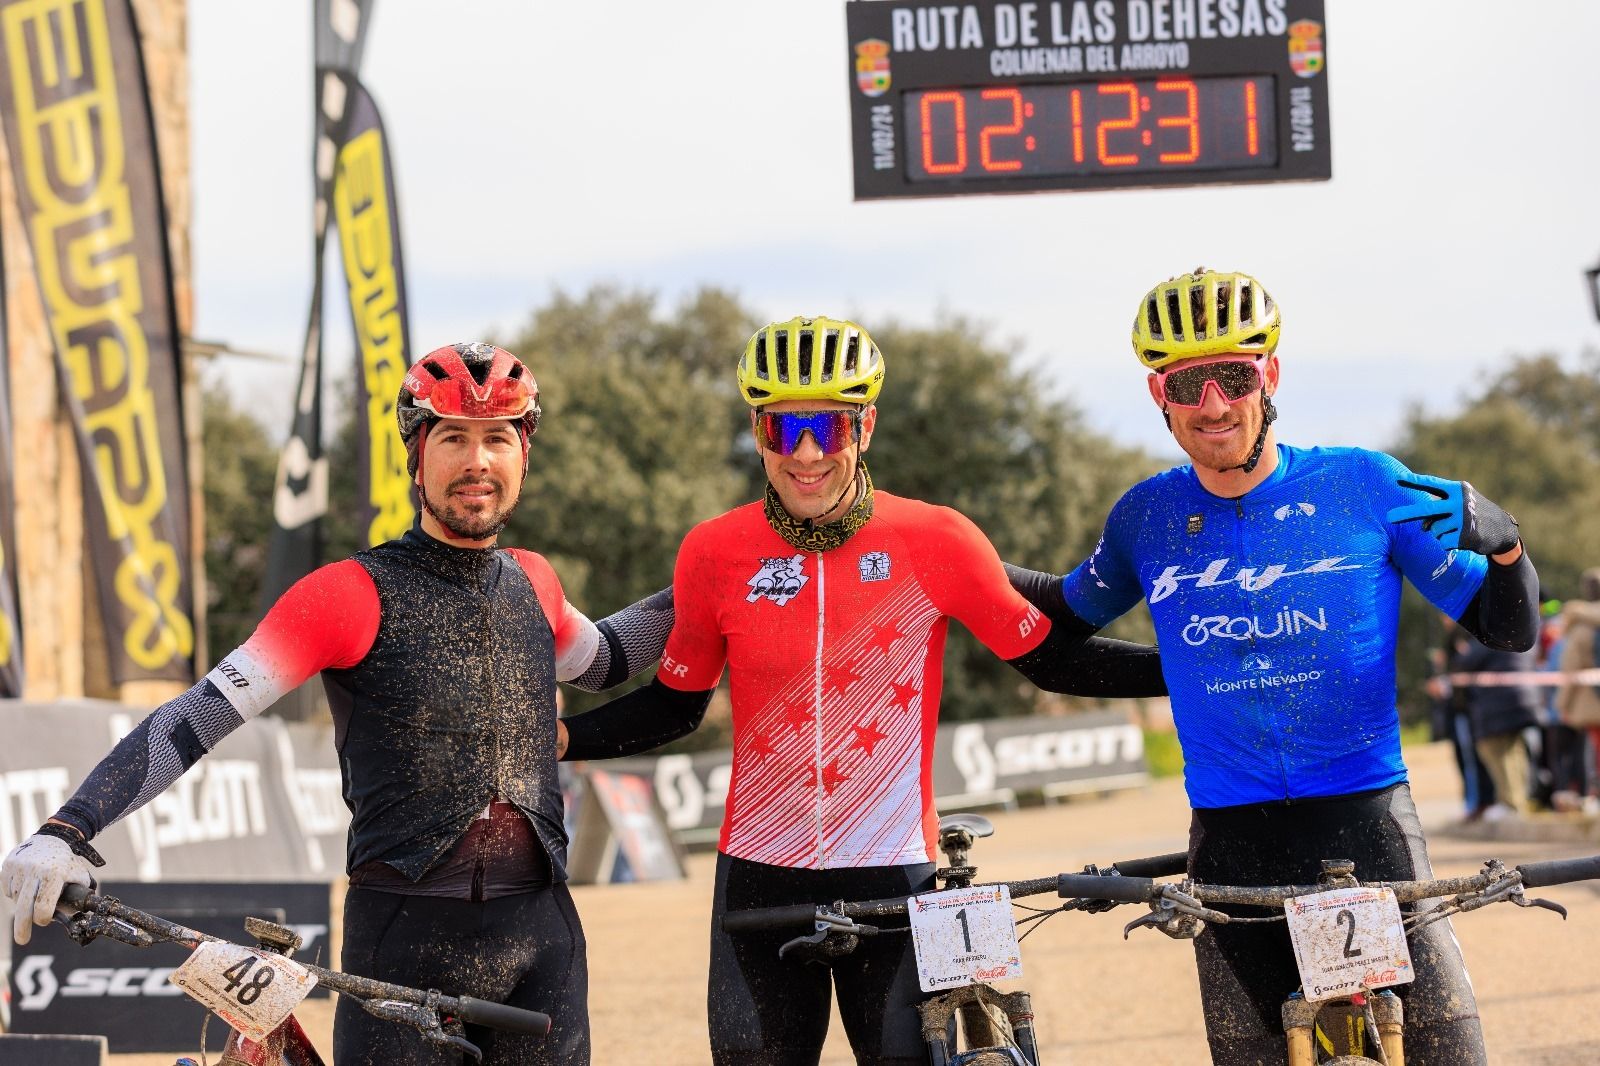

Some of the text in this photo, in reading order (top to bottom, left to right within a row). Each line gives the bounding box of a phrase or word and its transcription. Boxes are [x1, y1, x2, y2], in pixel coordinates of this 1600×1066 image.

[892, 0, 1288, 52] RUTA DE LAS DEHESAS
[991, 42, 1189, 76] COLMENAR DEL ARROYO
[1205, 670, 1321, 694] MONTE NEVADO
[956, 909, 972, 953] 1
[1336, 909, 1362, 959] 2
[223, 956, 275, 1006] 48
